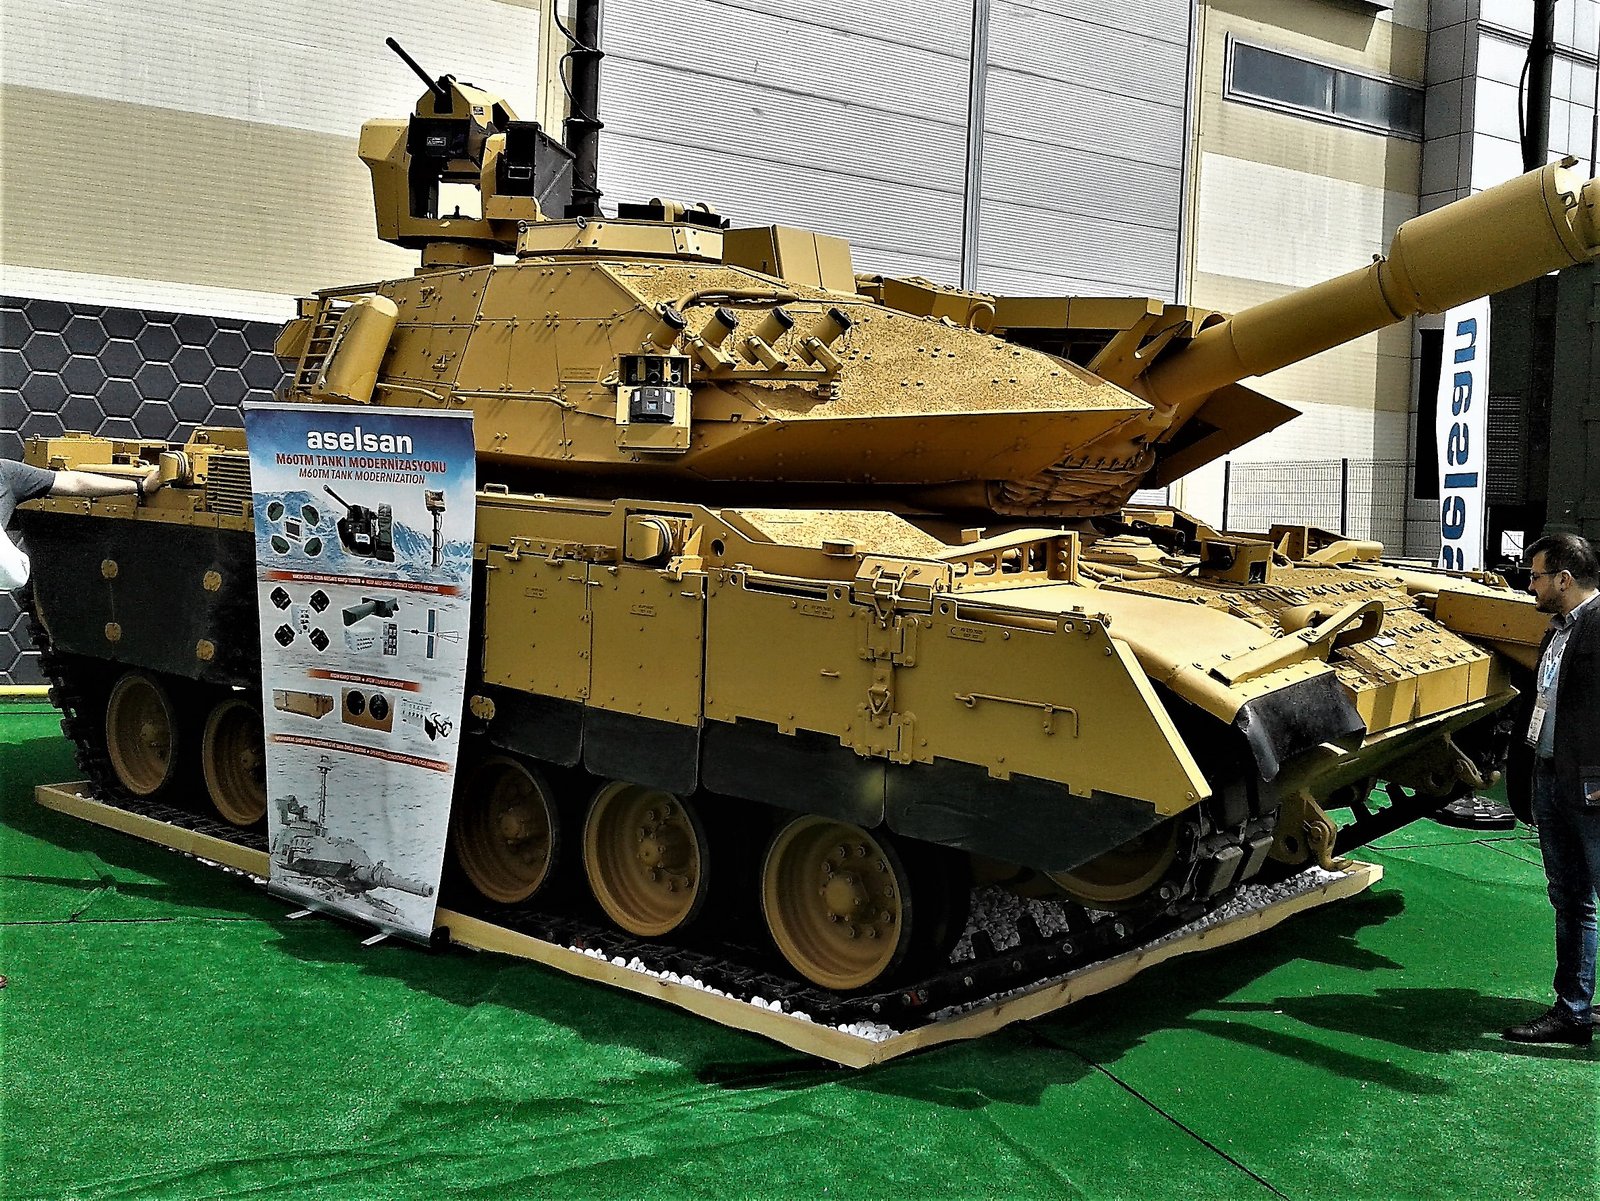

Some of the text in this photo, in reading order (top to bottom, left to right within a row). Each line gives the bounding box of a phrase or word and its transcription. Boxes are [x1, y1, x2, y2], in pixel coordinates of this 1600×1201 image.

[307, 426, 413, 454] aselsan
[276, 453, 447, 473] M60TM TANKI MODERNİZASYONU
[299, 468, 426, 485] M60TM TANK MODERNIZATION
